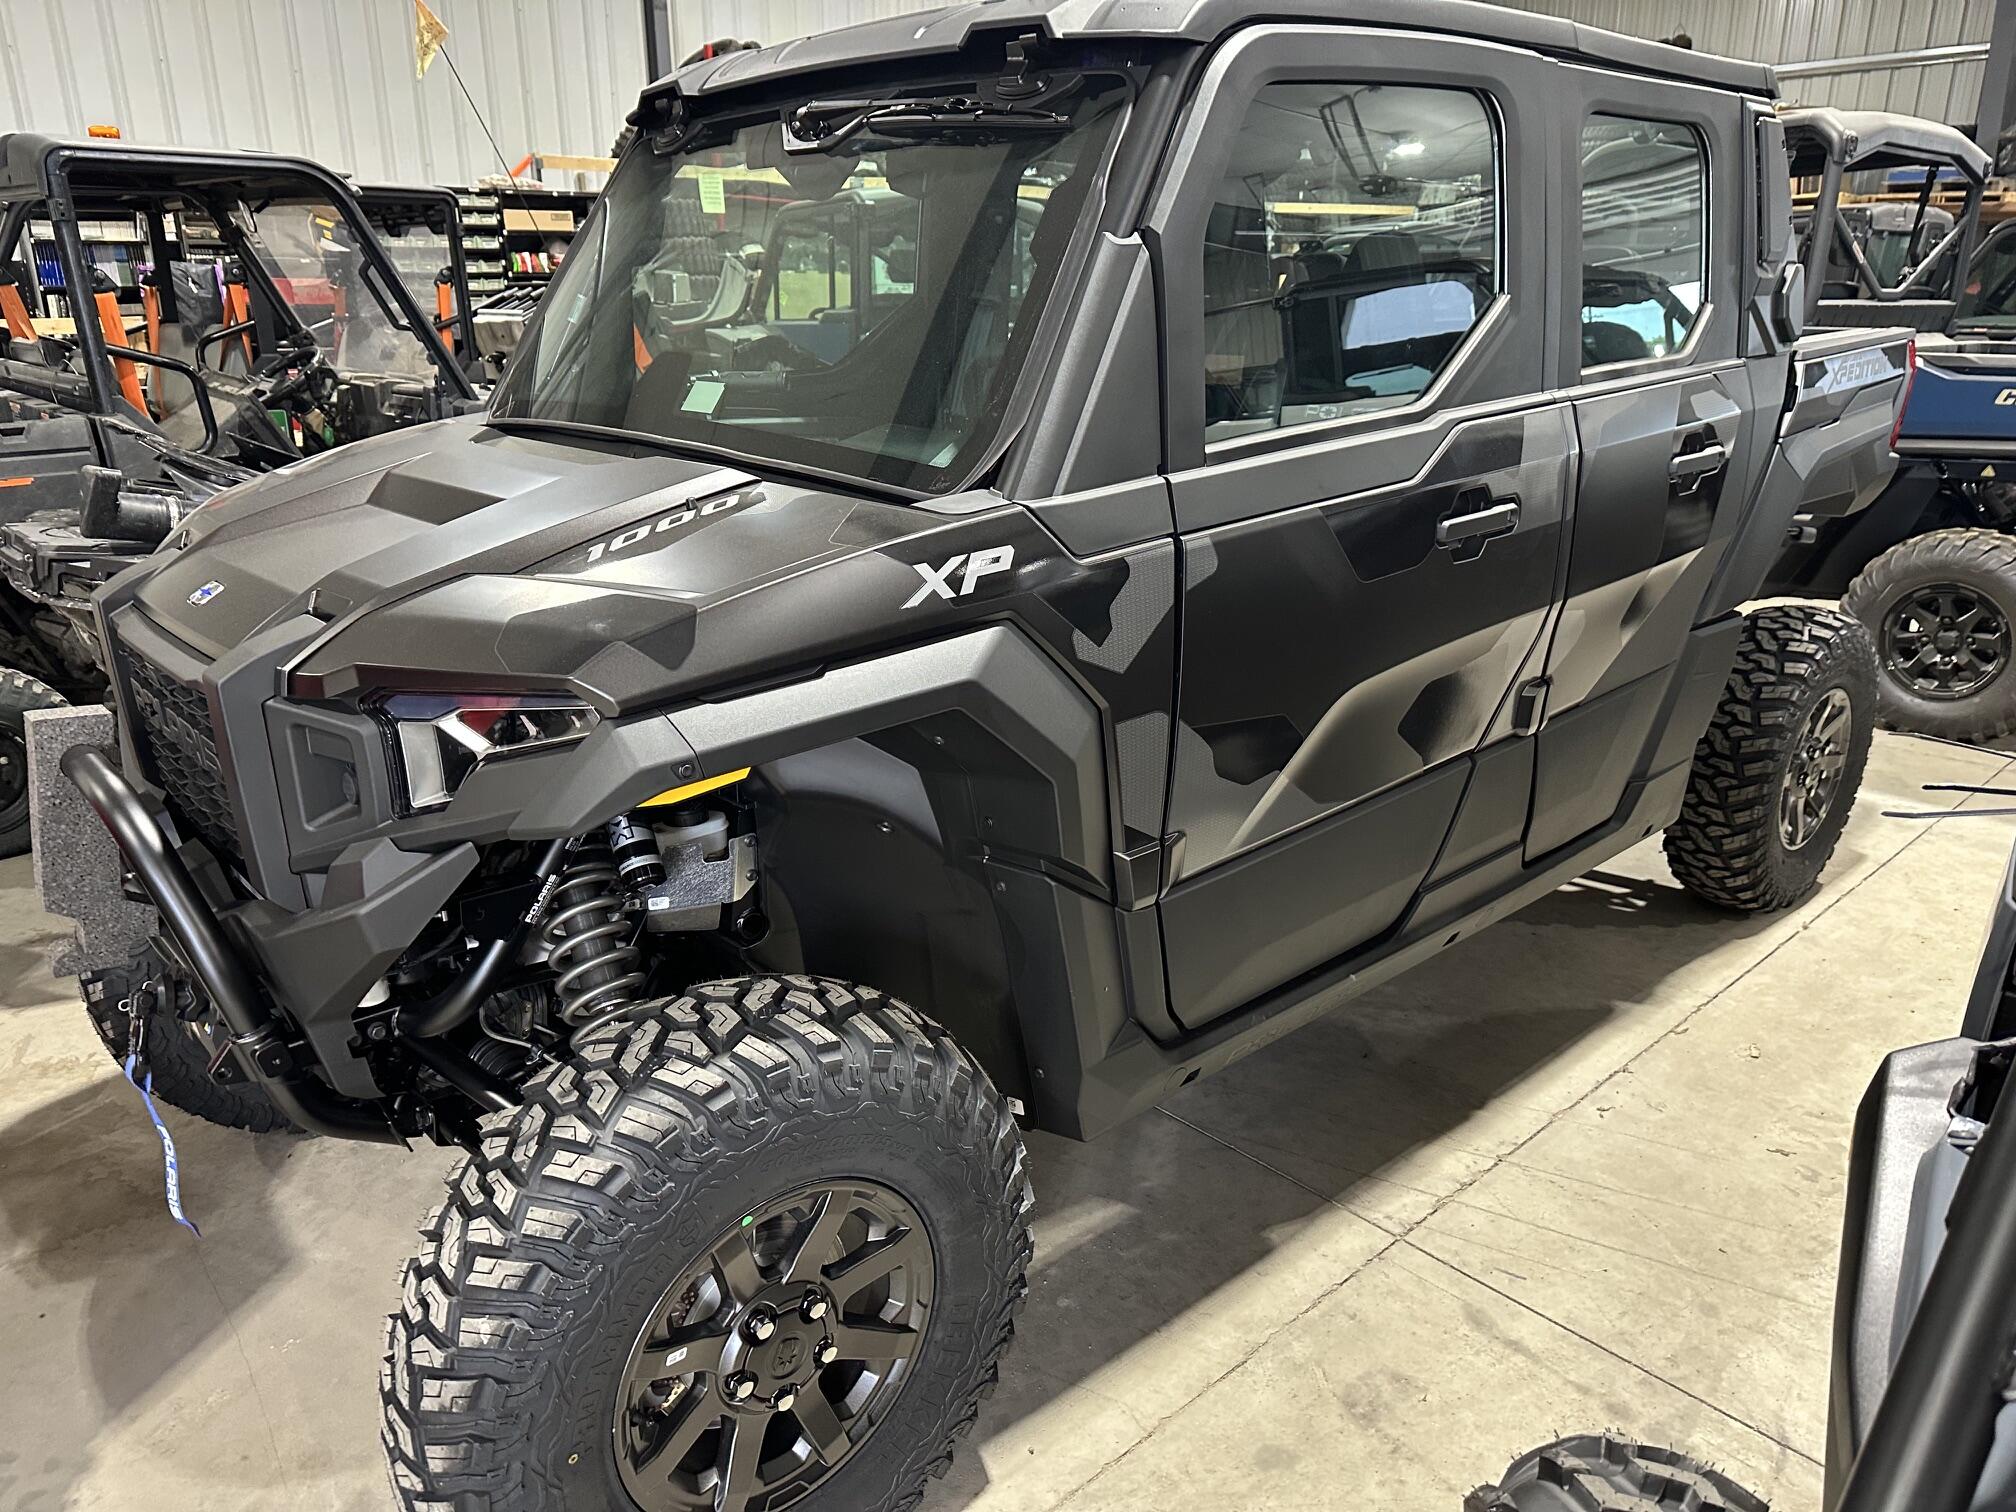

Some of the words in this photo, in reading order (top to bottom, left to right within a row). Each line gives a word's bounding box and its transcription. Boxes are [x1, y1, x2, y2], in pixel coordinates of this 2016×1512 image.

[586, 494, 741, 563] 1000
[899, 544, 1015, 610] XP
[524, 873, 557, 924] POLARIS
[156, 1125, 184, 1220] POLARIS
